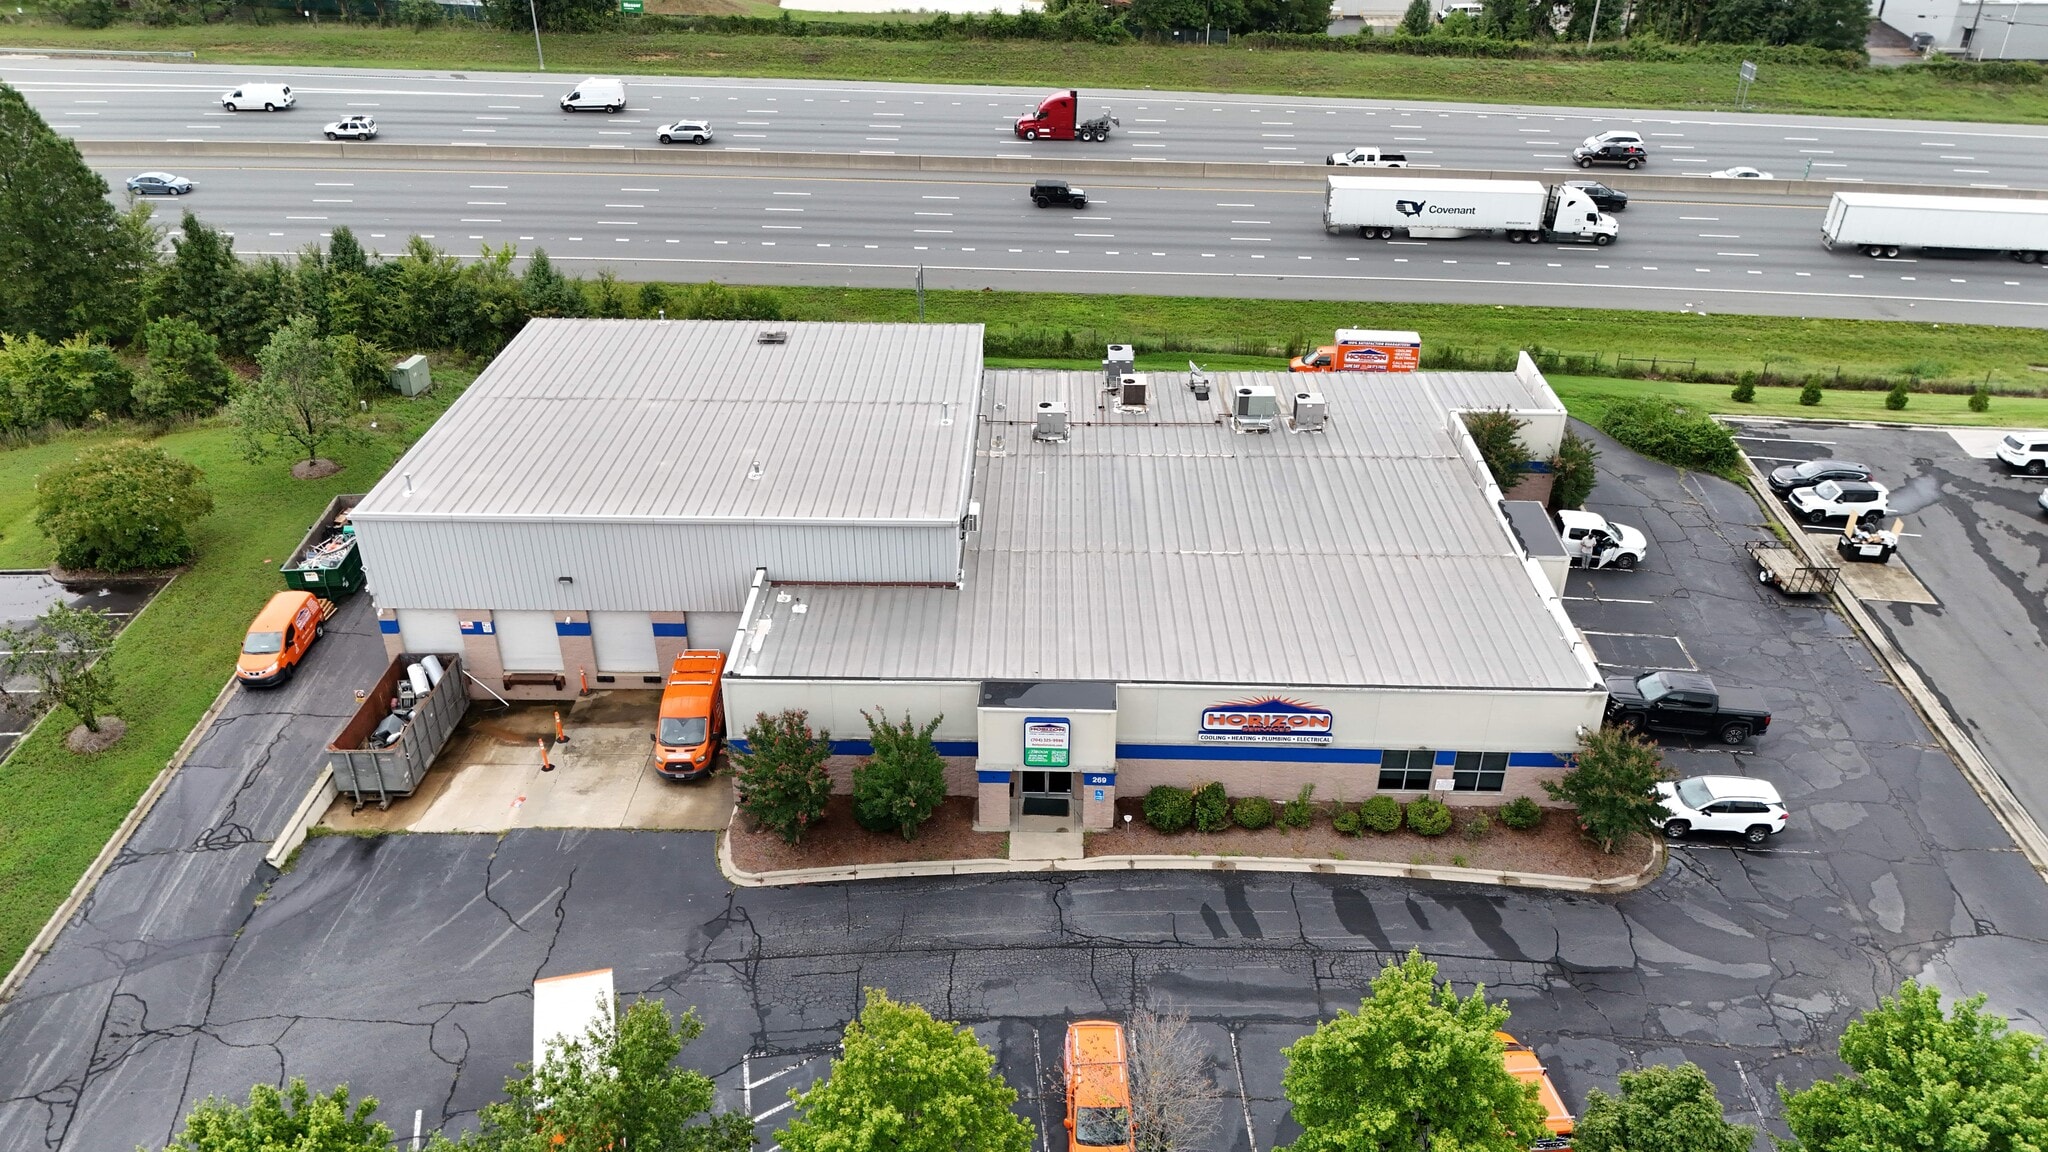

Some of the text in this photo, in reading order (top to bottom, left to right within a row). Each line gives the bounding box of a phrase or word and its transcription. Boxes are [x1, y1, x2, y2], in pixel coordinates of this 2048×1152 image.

[1428, 205, 1476, 215] Covenant
[1207, 713, 1330, 728] HORIZON
[1092, 776, 1107, 784] 269
